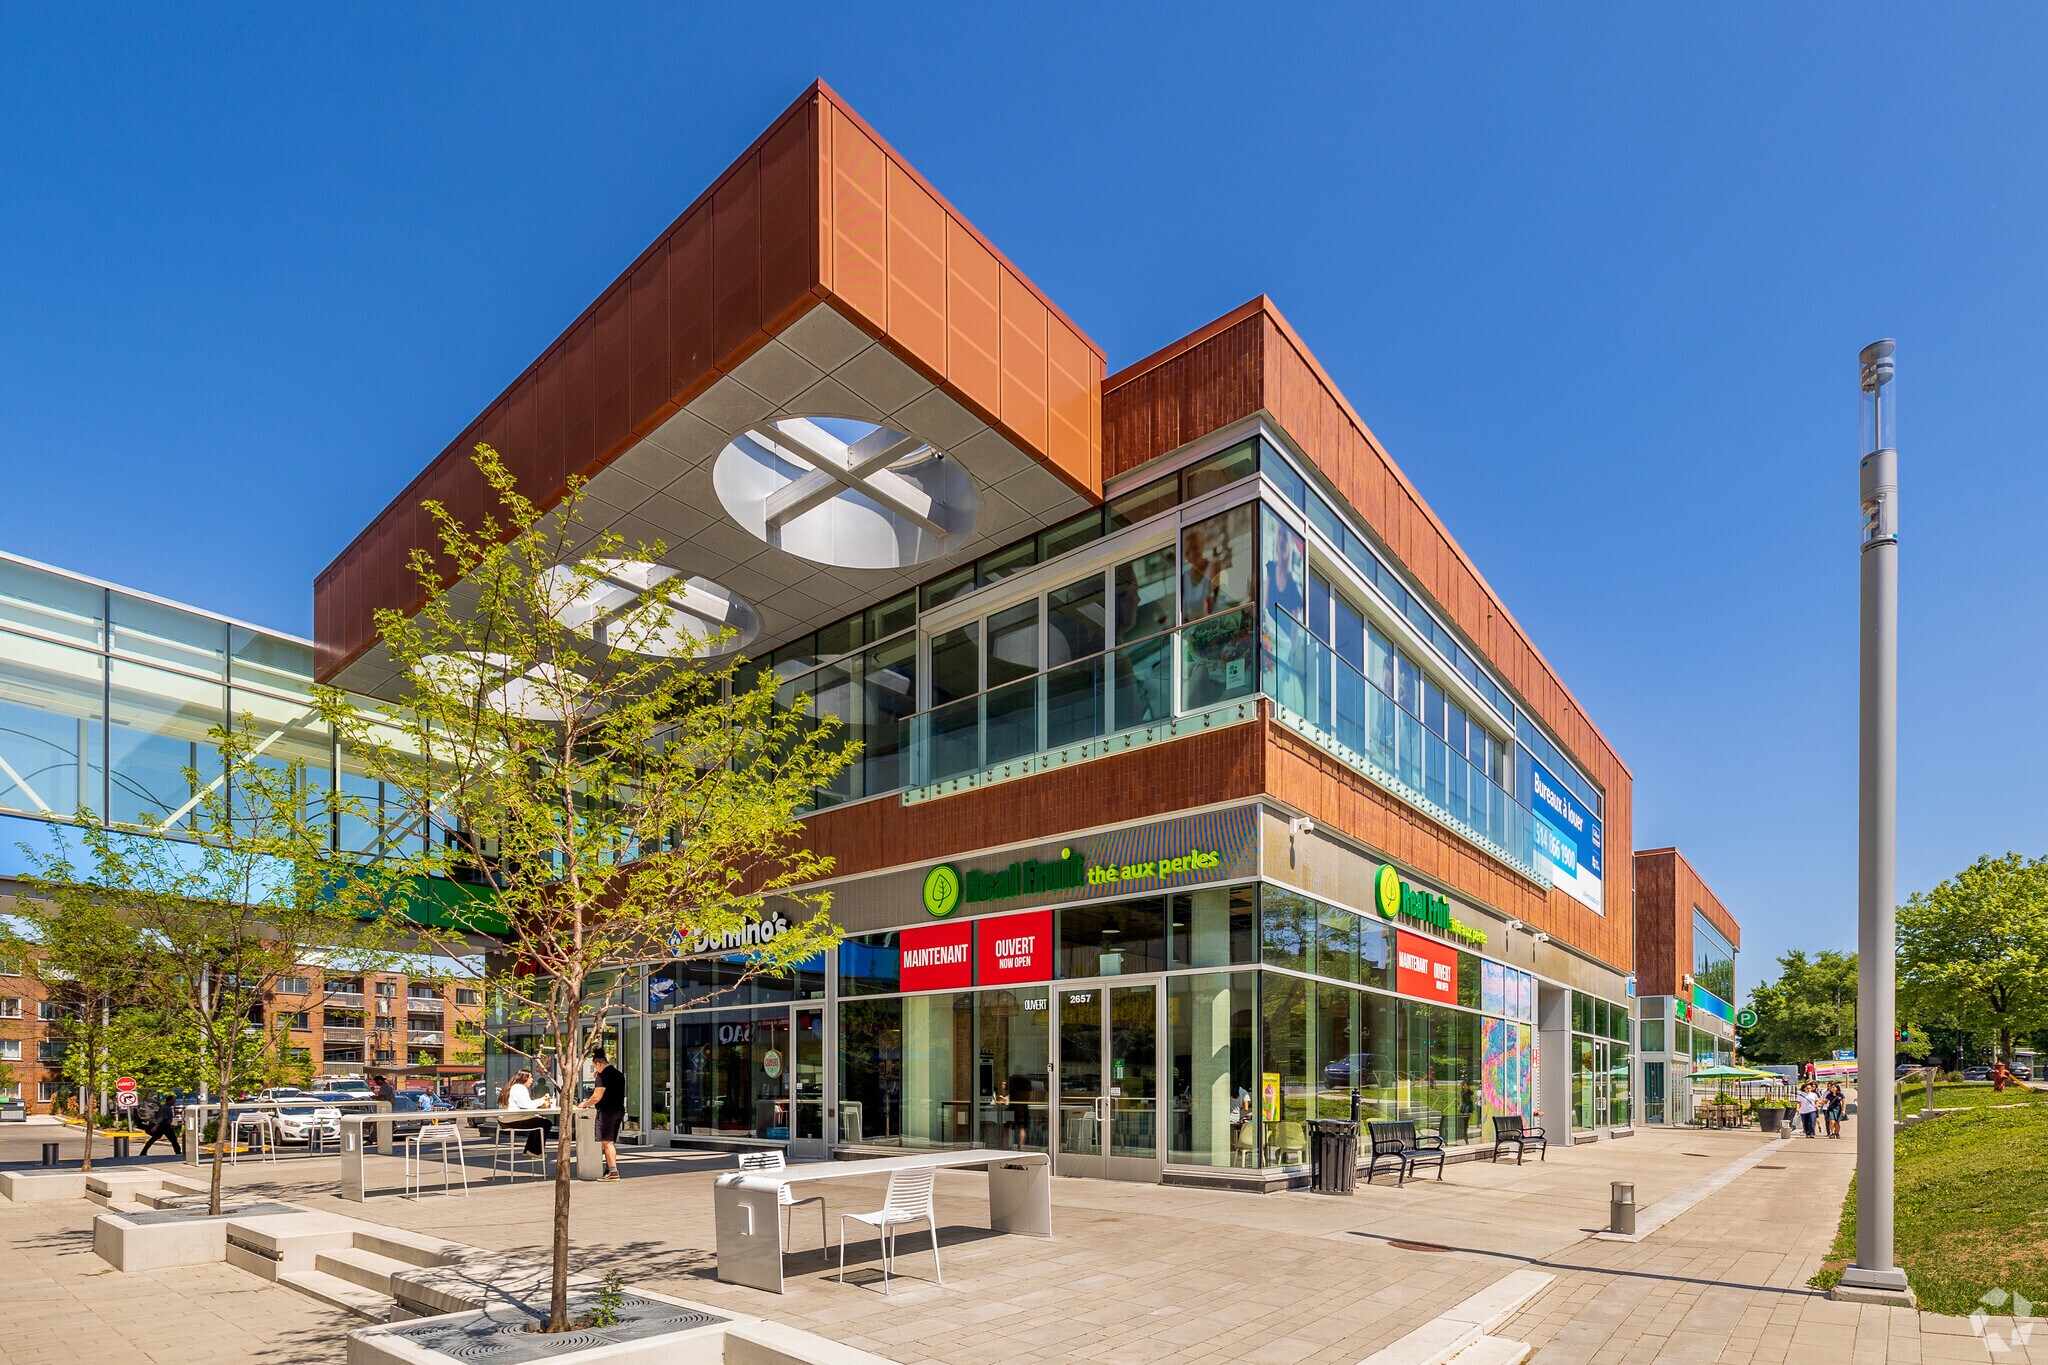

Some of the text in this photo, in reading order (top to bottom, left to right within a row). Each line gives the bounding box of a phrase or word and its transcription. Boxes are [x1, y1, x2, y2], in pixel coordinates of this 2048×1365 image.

[1534, 771, 1584, 832] Bureaux à louer
[1535, 822, 1549, 848] 514
[1549, 834, 1561, 861] 866
[1561, 843, 1576, 871] 1900
[966, 848, 1220, 903] Real Fruit thé aux perles
[1400, 881, 1427, 921] Real
[903, 944, 968, 969] MAINTENANT
[995, 936, 1035, 957] OUVERT
[999, 956, 1031, 969] NOW OPEN
[1399, 951, 1452, 983] MAINTENANT OUVERT
[1024, 999, 1048, 1011] OUVERT
[1069, 994, 1091, 1004] 2657
[1741, 1013, 1751, 1025] P
